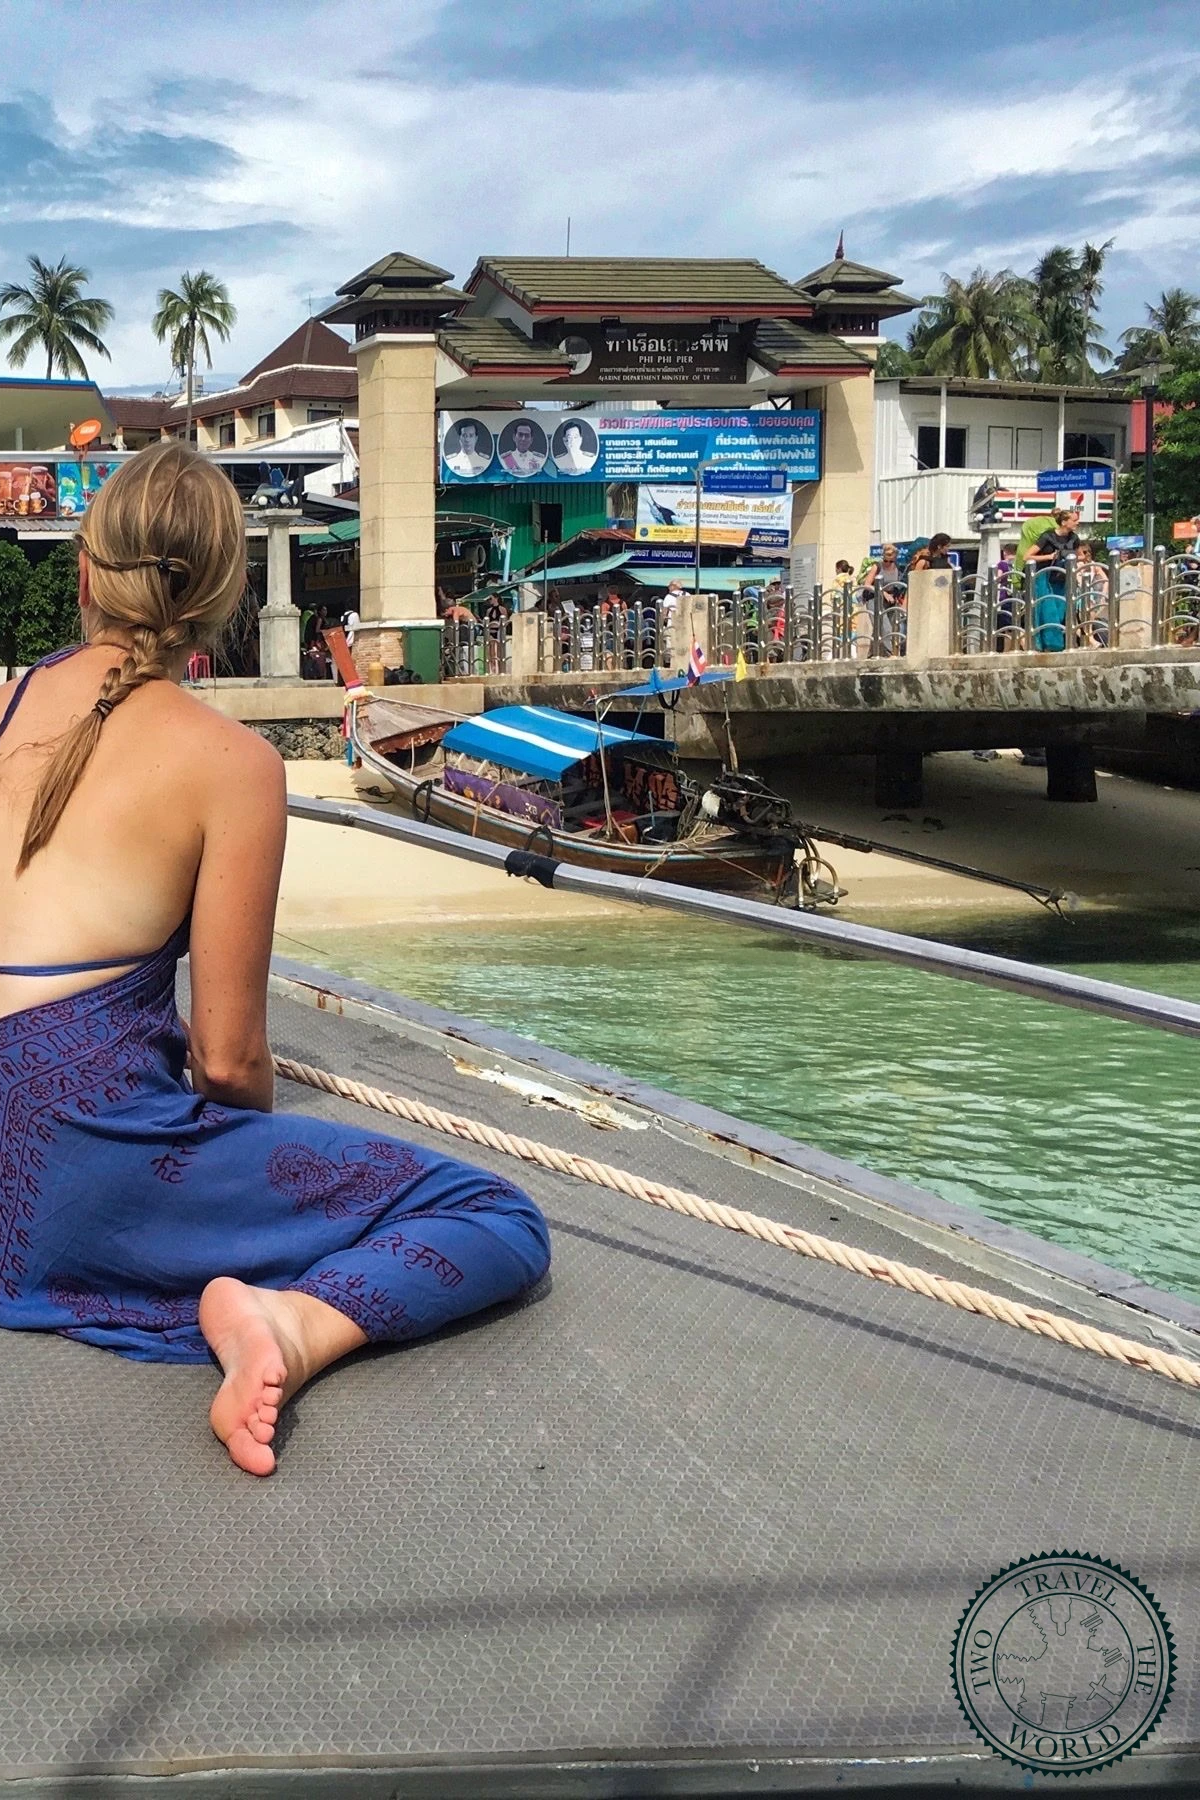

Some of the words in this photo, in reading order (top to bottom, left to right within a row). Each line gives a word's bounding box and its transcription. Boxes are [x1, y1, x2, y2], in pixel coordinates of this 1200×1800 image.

[605, 332, 729, 352] ทาเรือเกาะพีพี
[638, 356, 654, 364] PHI
[657, 356, 672, 364] PHI
[676, 356, 694, 364] PIER
[622, 374, 661, 382] DEPARTMENT
[661, 374, 690, 382] MINISTRY
[715, 432, 815, 446] ที่ช่วยกันผลักดันให้
[651, 549, 693, 559] INFORMATION
